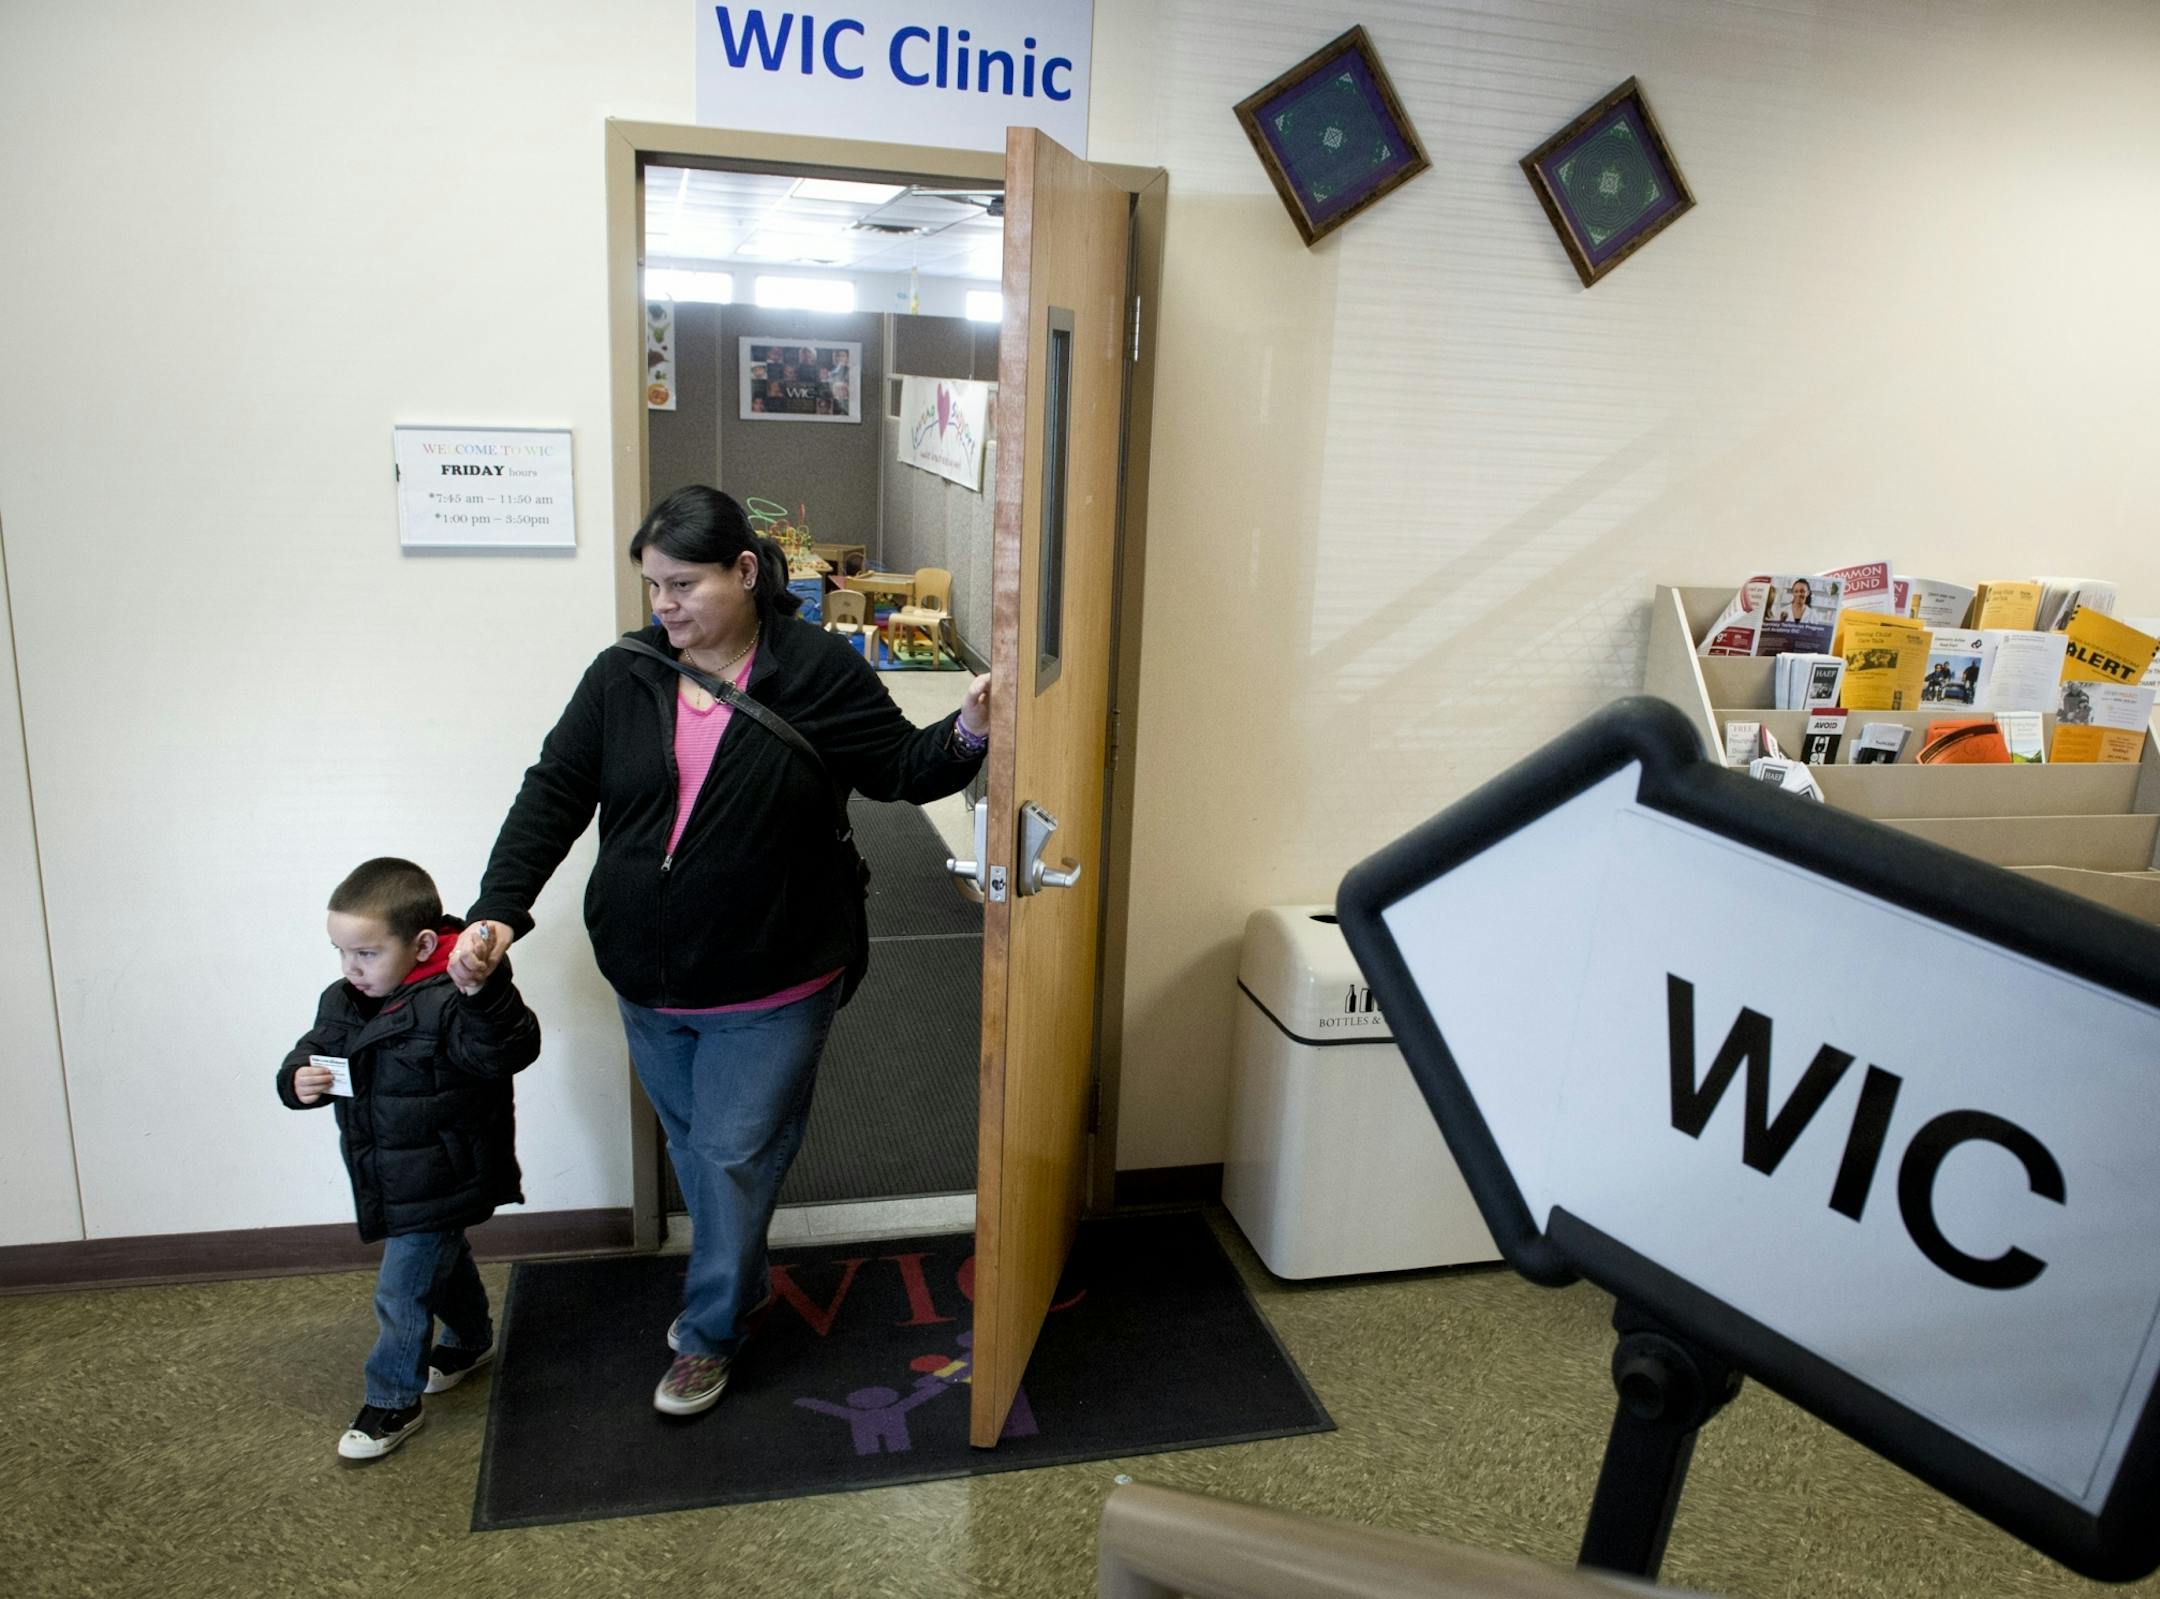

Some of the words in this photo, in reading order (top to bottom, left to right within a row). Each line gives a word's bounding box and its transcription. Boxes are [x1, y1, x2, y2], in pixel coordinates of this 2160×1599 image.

[715, 6, 865, 80] WIC
[888, 26, 1073, 102] Clinic
[423, 443, 497, 456] WECOME
[500, 445, 521, 456] TO
[524, 446, 553, 457] WIC
[441, 464, 505, 476] FRIDAY
[508, 468, 538, 477] hours
[465, 496, 484, 504] am
[500, 494, 532, 504] 11:50
[535, 496, 553, 505] am
[471, 515, 491, 527] pm
[505, 514, 550, 527] 3:50pm
[1844, 578, 1880, 592] OUND
[2066, 641, 2137, 681] ALERT
[1319, 1016, 1369, 1028] BOTTLES
[1371, 1016, 1381, 1025] &
[1667, 971, 2067, 1292] WIC
[745, 1252, 1088, 1338] WI
